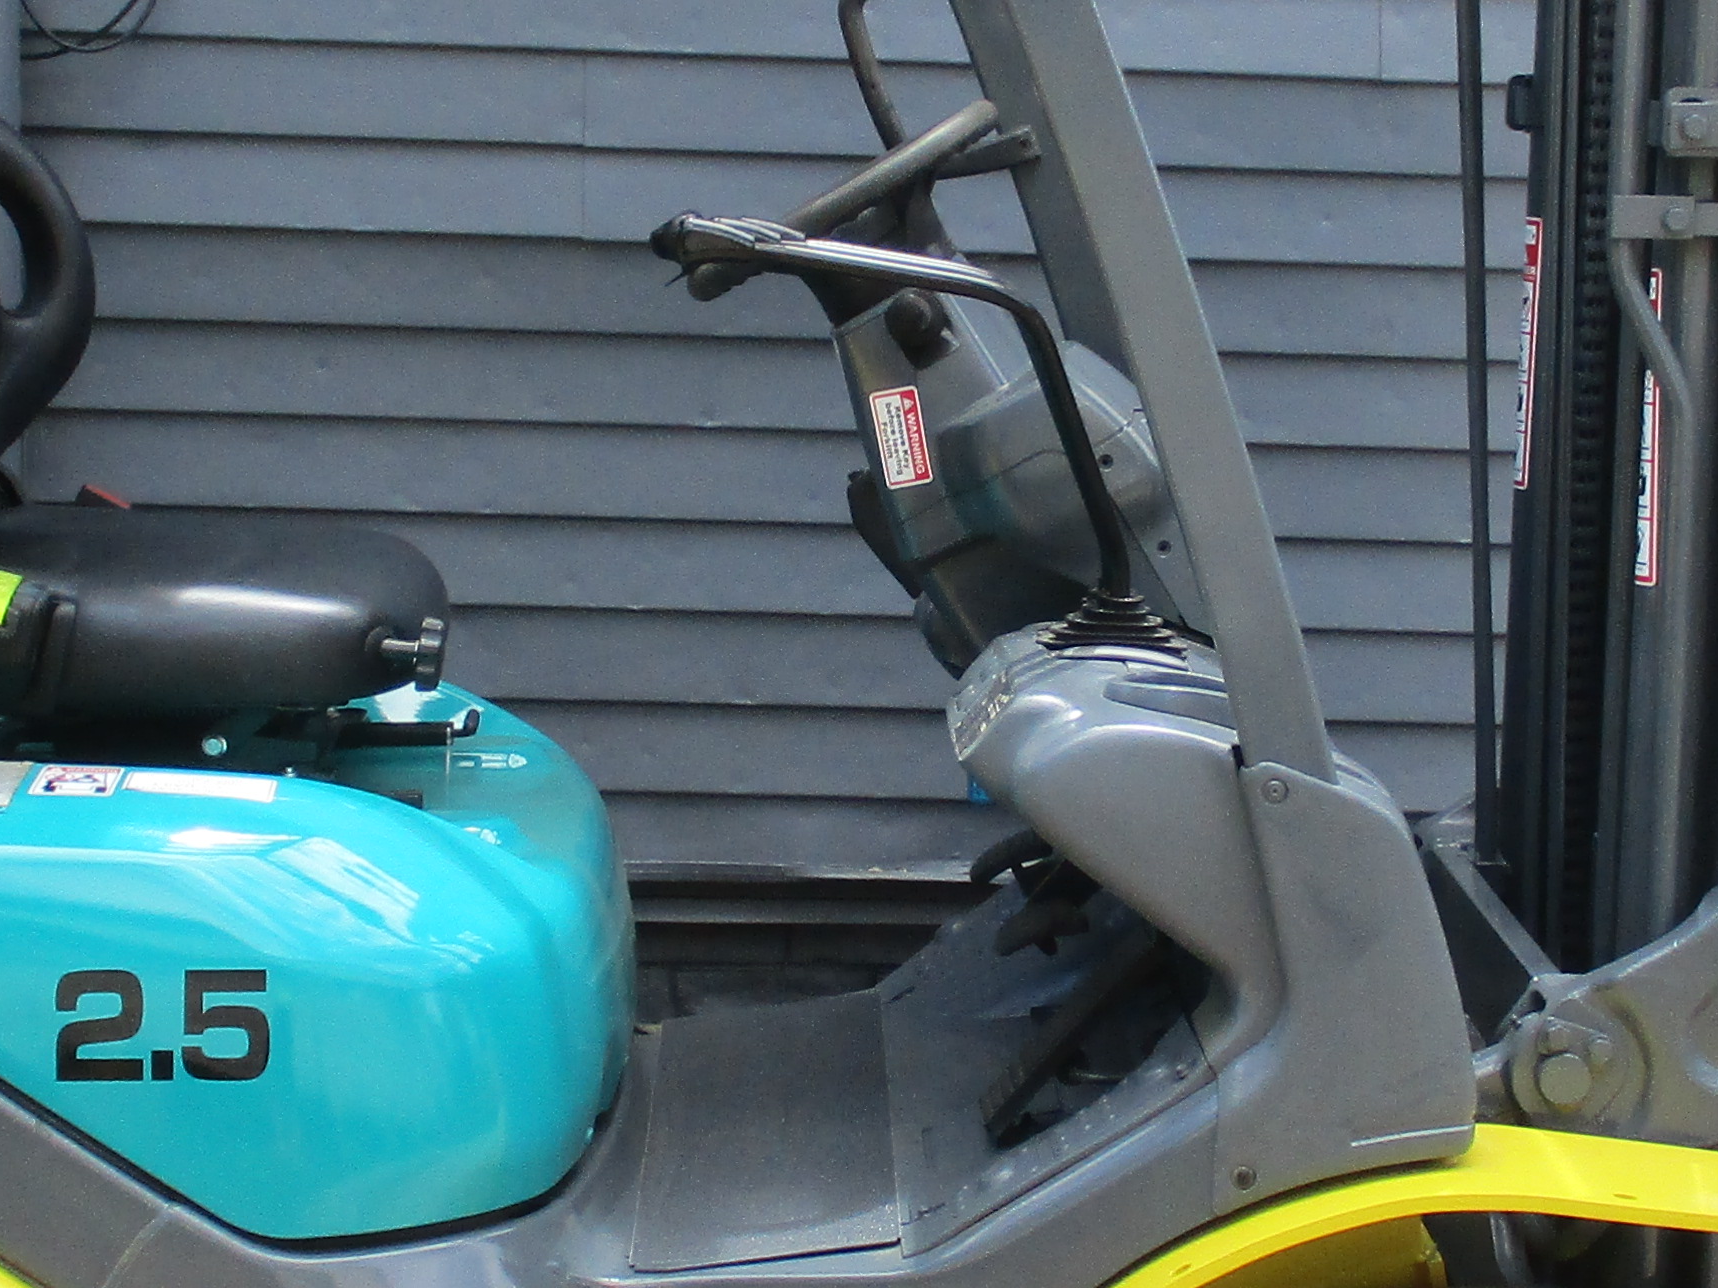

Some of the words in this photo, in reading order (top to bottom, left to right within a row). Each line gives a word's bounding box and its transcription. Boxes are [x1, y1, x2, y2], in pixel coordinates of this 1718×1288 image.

[881, 422, 893, 459] Forklift
[885, 401, 896, 436] before
[892, 438, 904, 475] leaving
[894, 406, 906, 447] Remove
[902, 449, 910, 469] Key
[905, 411, 926, 475] WARNING
[54, 968, 272, 1083] 2.5
